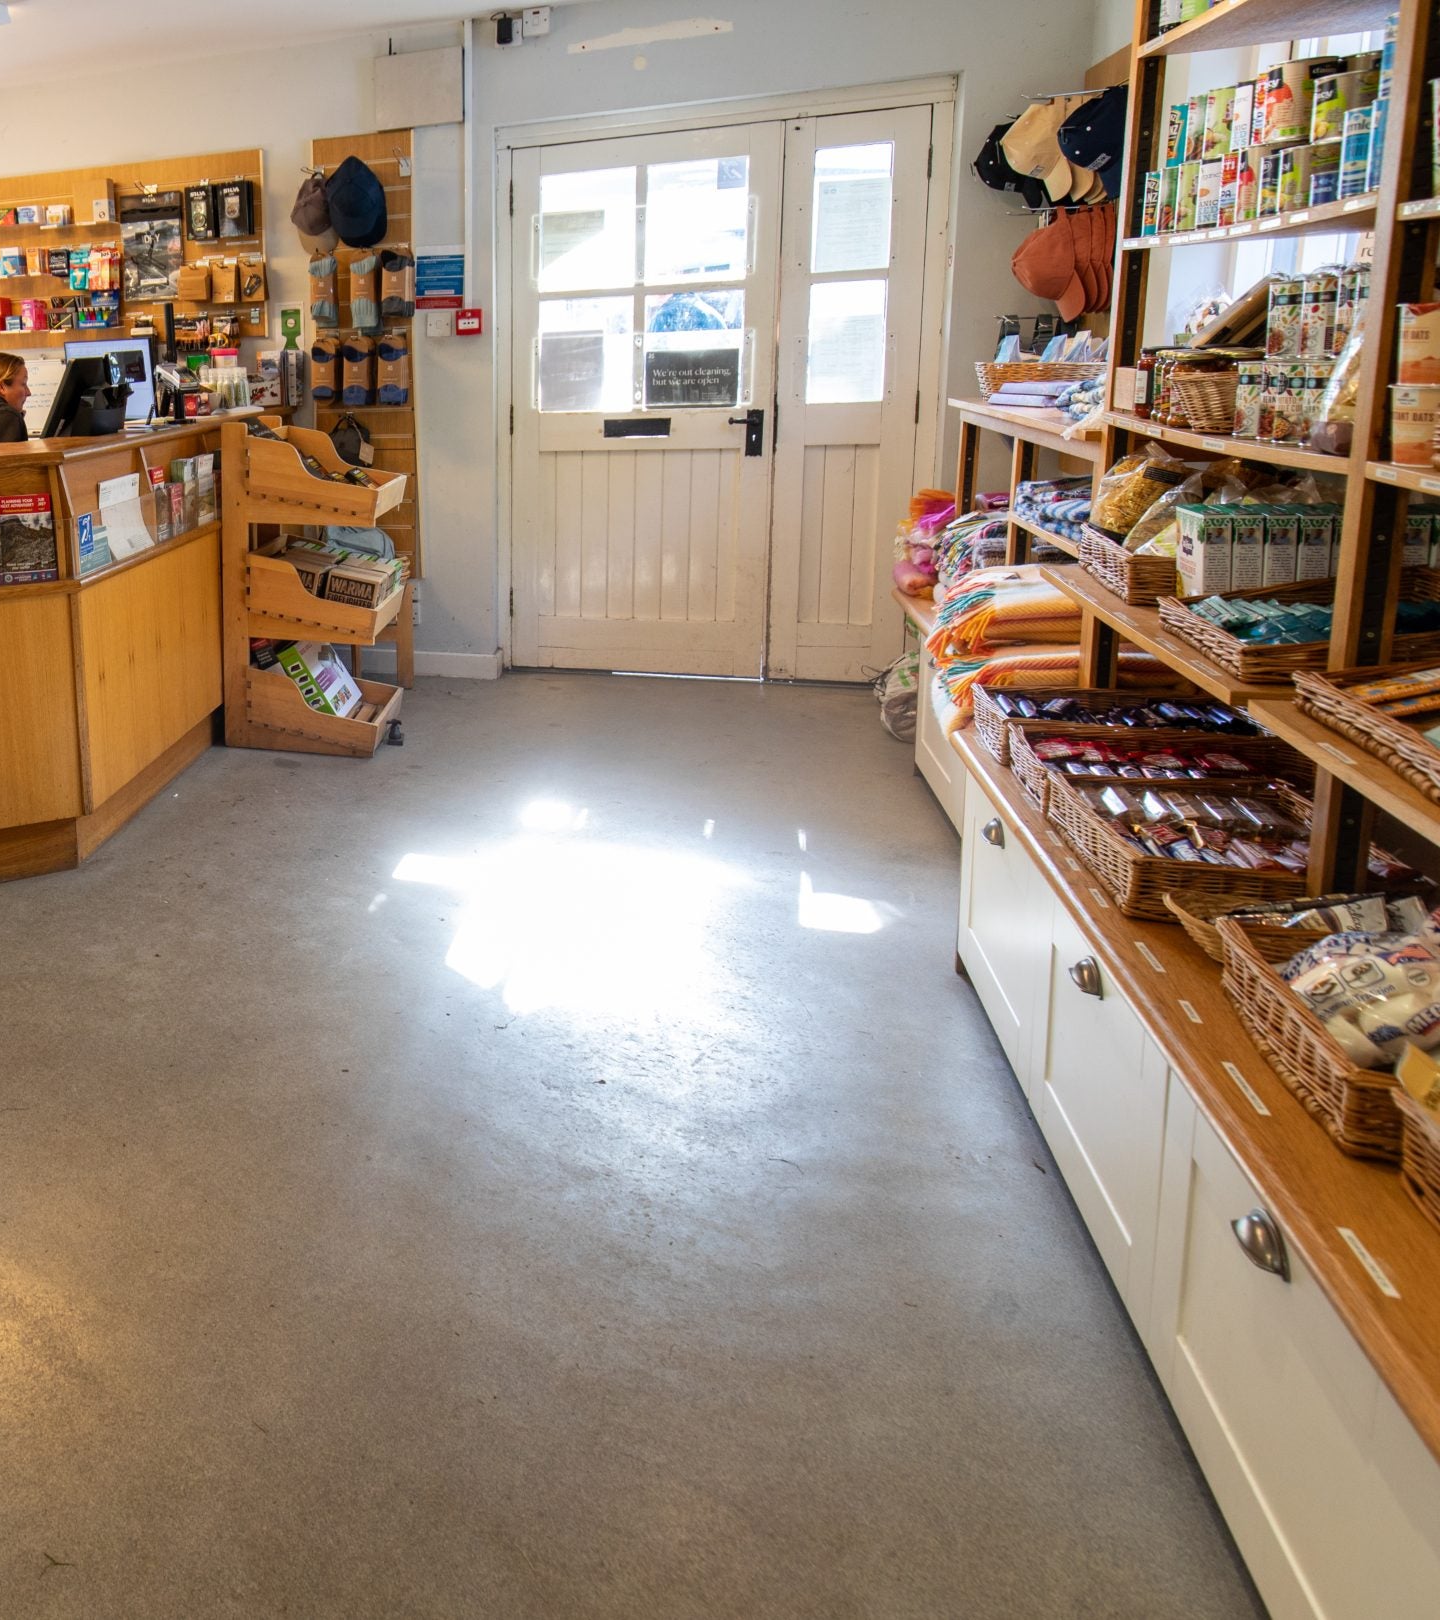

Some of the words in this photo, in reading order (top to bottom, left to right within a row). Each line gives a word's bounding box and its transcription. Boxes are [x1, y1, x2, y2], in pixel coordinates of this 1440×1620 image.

[223, 186, 240, 194] SILVA
[1410, 329, 1431, 341] OATS
[652, 368, 677, 377] We're
[678, 369, 693, 377] out
[694, 367, 732, 376] cleaning,
[652, 378, 667, 386] but
[697, 377, 720, 387] open
[1412, 412, 1435, 422] OATS
[331, 576, 372, 600] WARMA
[1342, 901, 1363, 932] Galaxy
